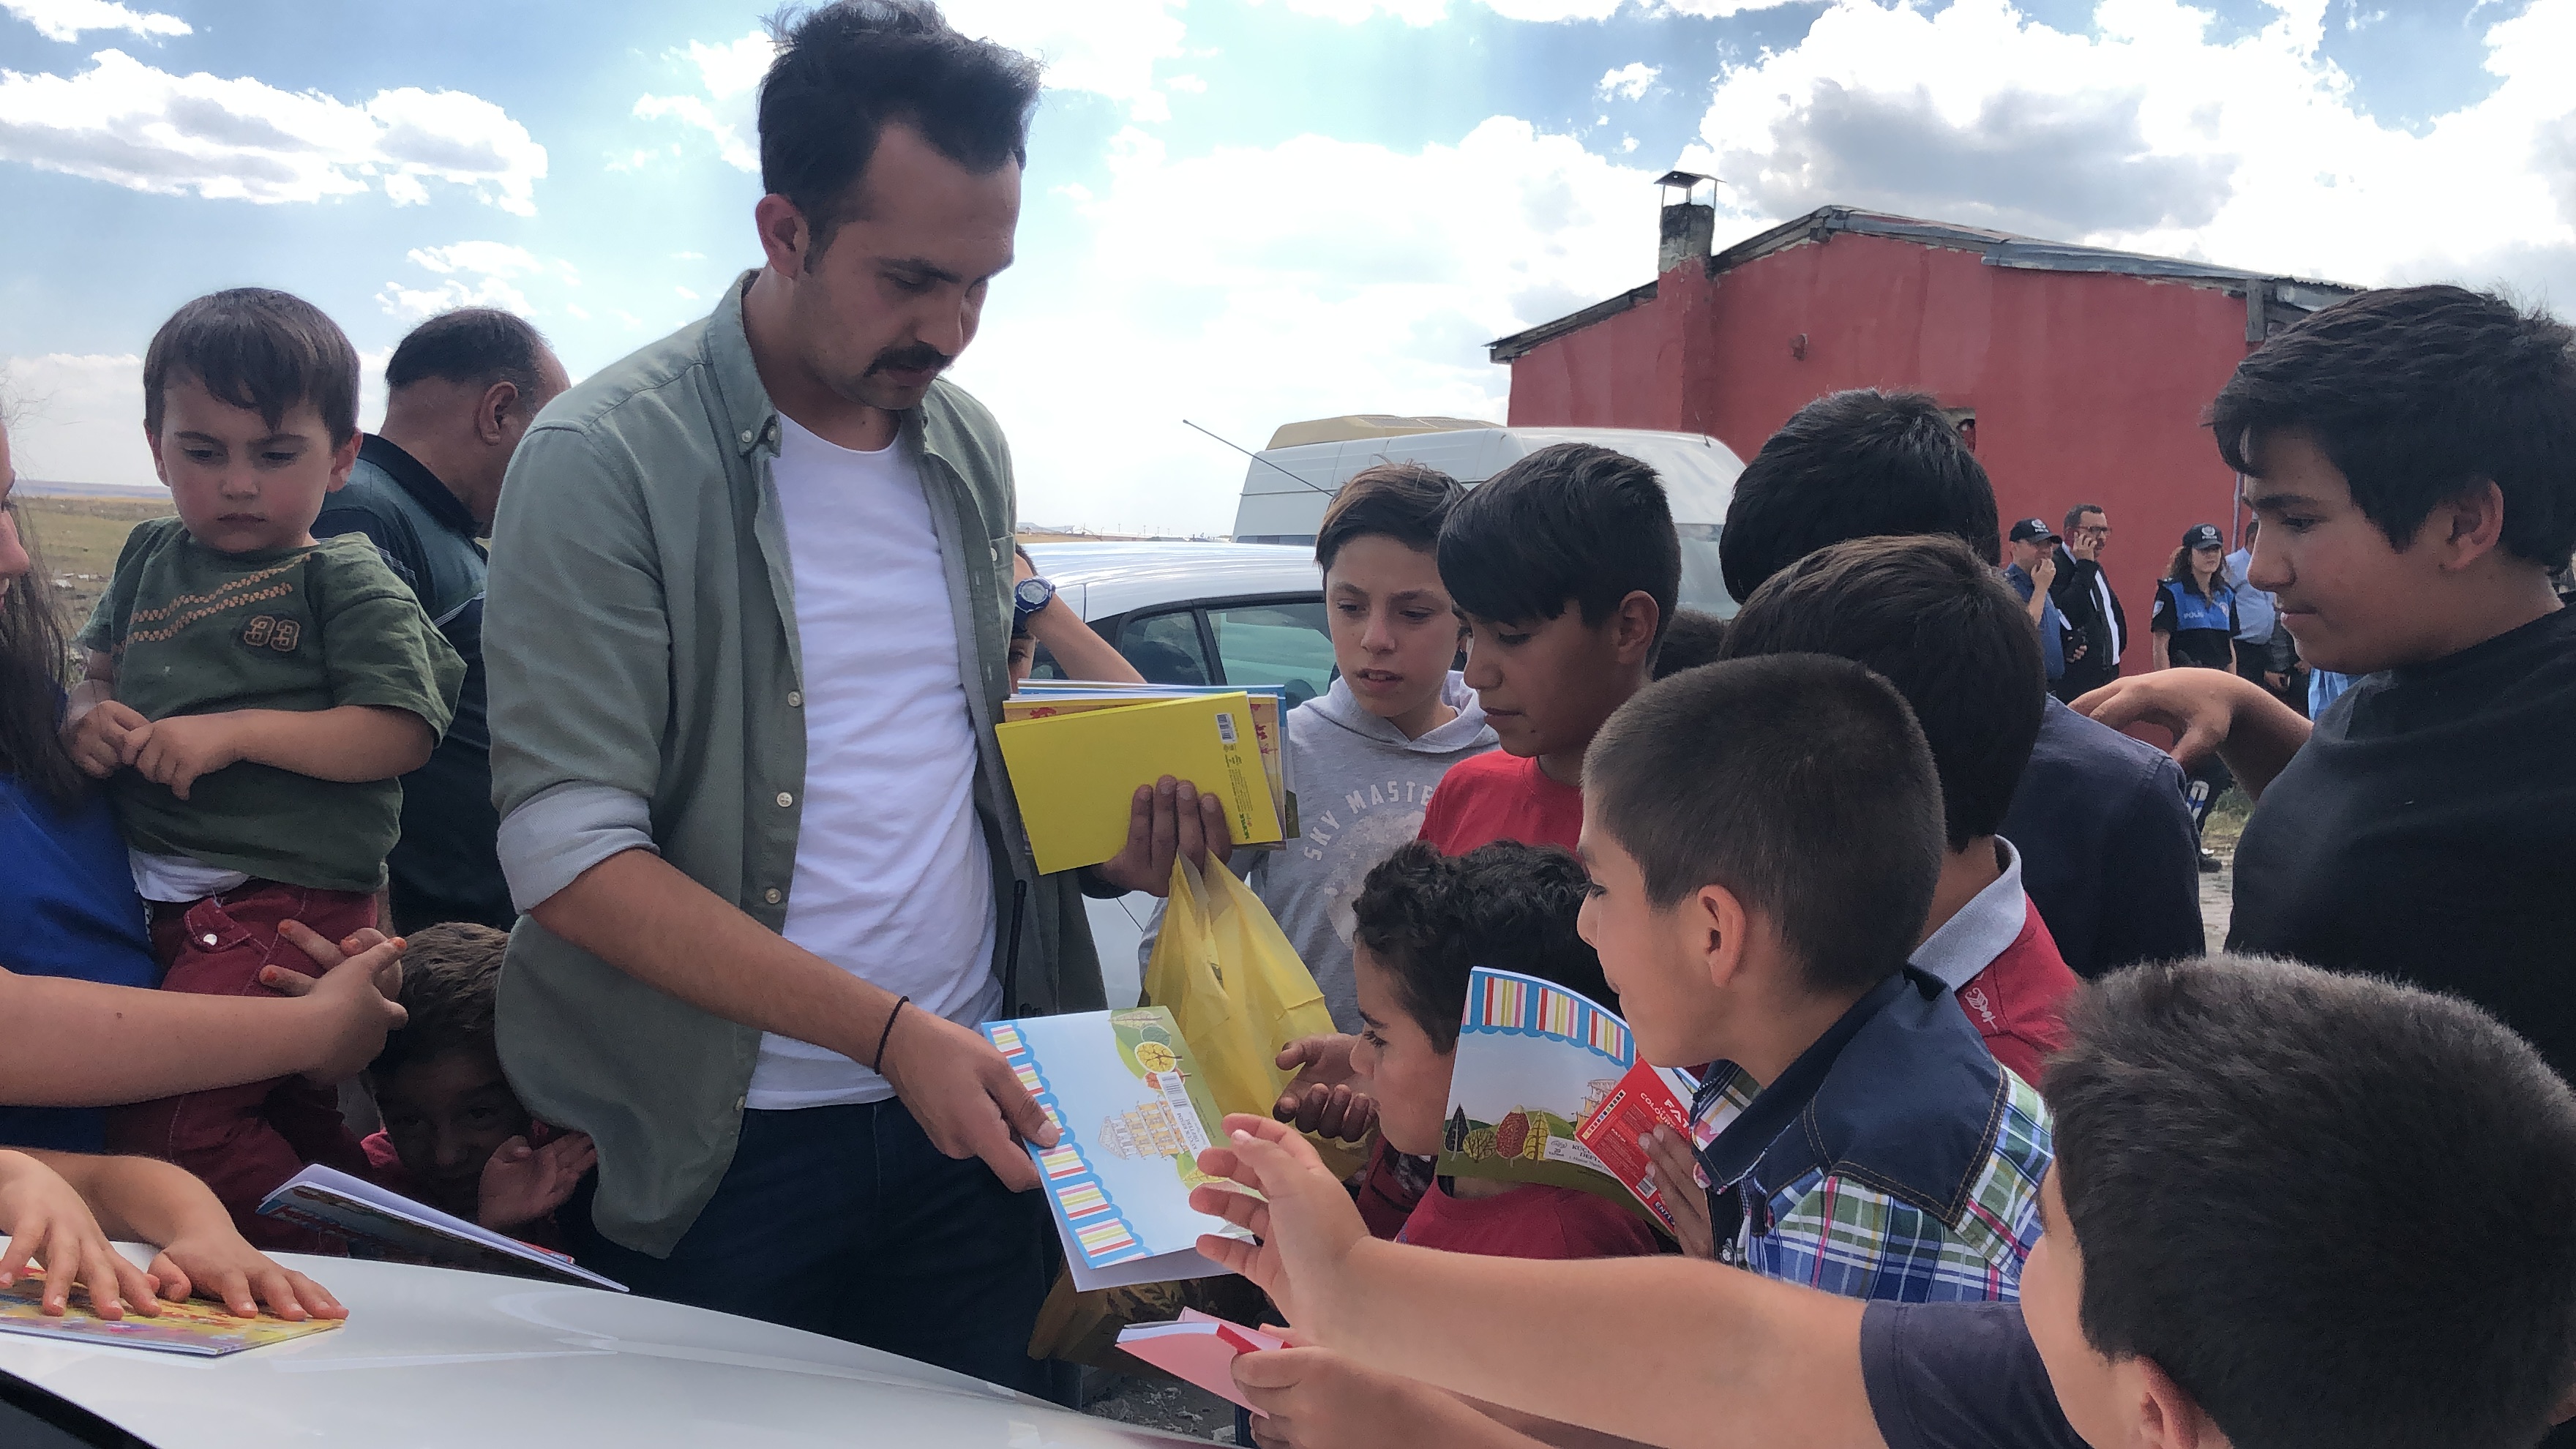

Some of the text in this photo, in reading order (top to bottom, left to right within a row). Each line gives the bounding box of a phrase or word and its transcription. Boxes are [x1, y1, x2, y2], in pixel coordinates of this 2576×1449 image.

[243, 615, 301, 651] 33
[1304, 780, 1434, 861] SKY MASTE
[1640, 1093, 1675, 1128] COLOUR
[1664, 1098, 1689, 1128] FAT
